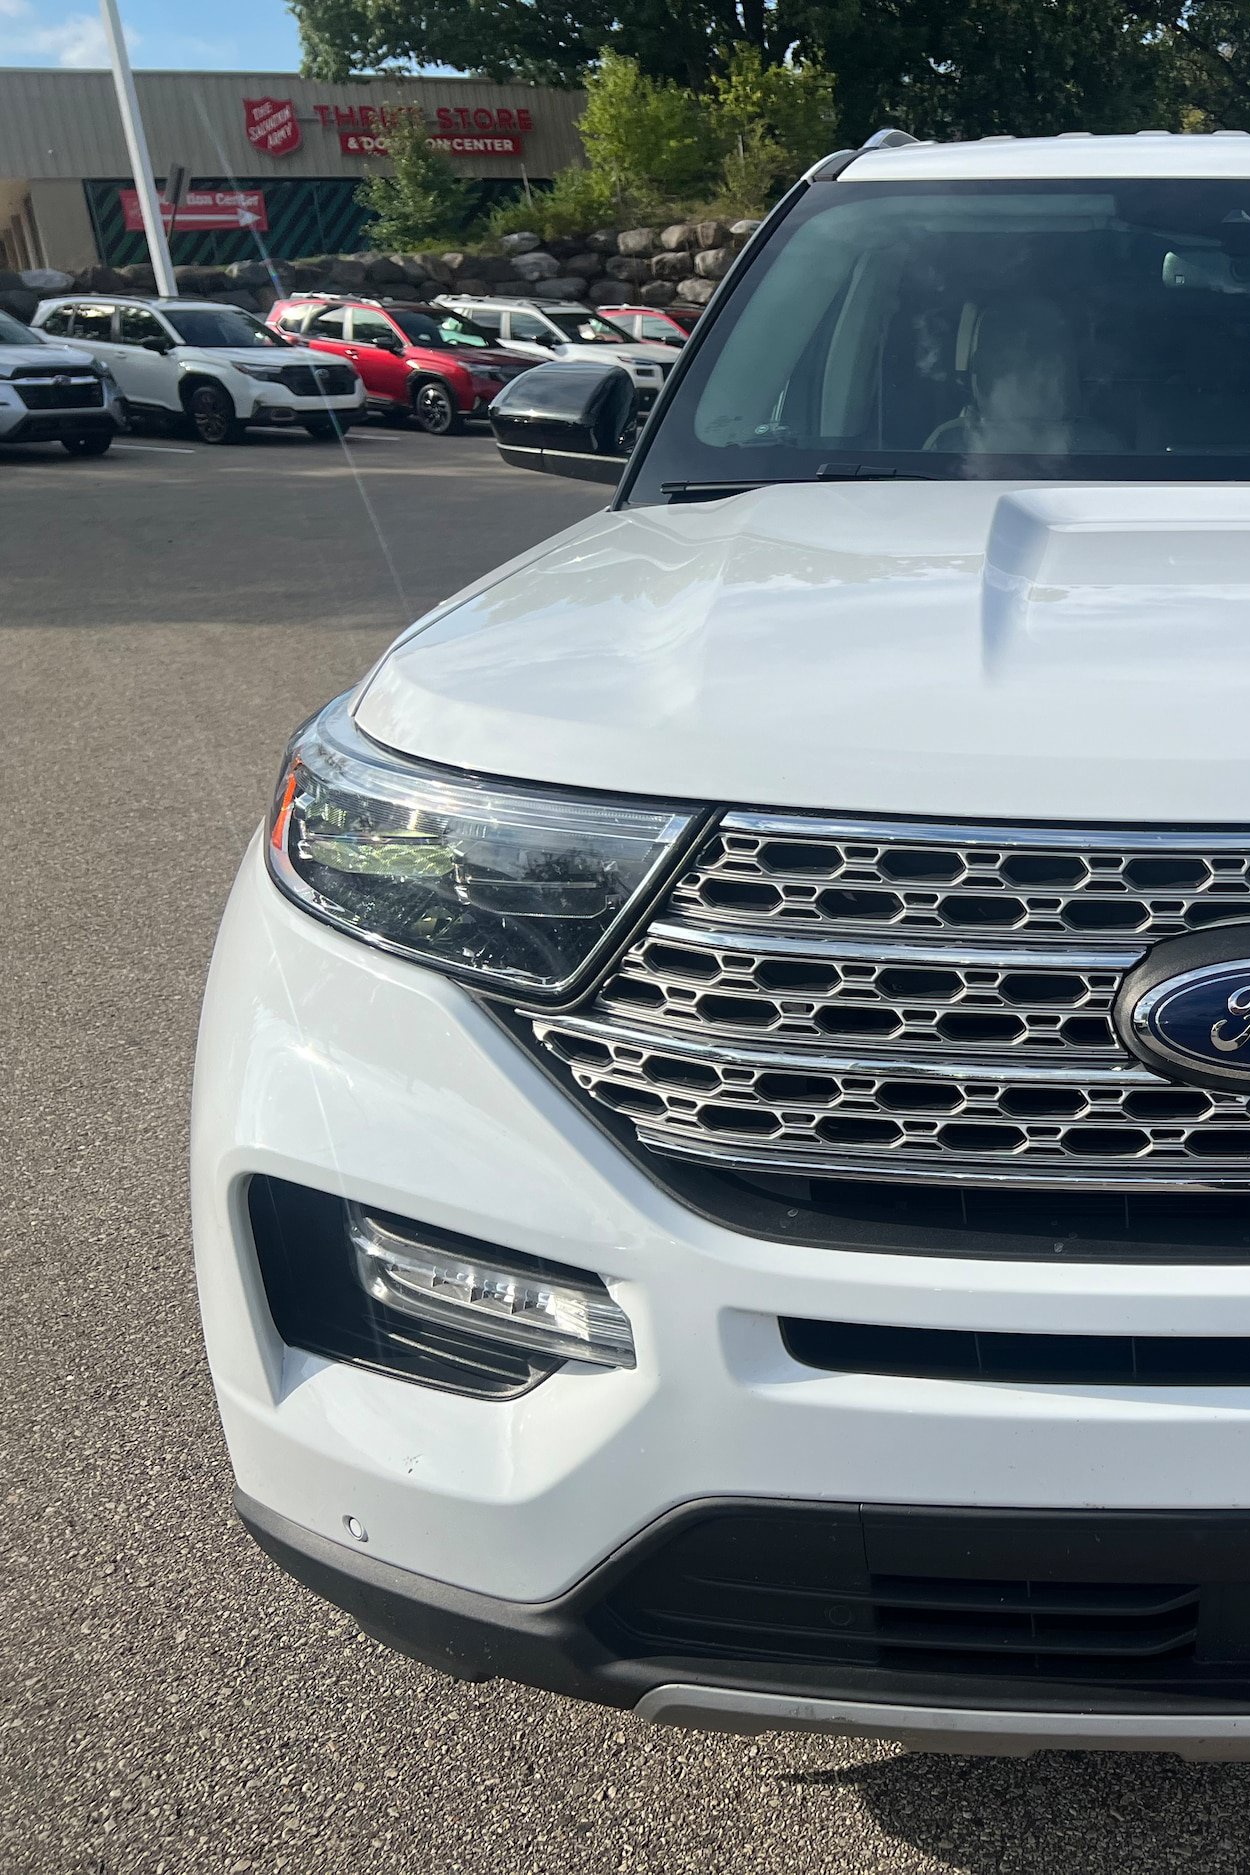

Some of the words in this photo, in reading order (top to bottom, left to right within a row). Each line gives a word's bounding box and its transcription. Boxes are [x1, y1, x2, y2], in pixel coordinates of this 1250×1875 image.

[436, 107, 533, 131] STORE
[347, 136, 359, 150] &
[360, 137, 452, 151] DOON
[452, 138, 514, 151] CENTER
